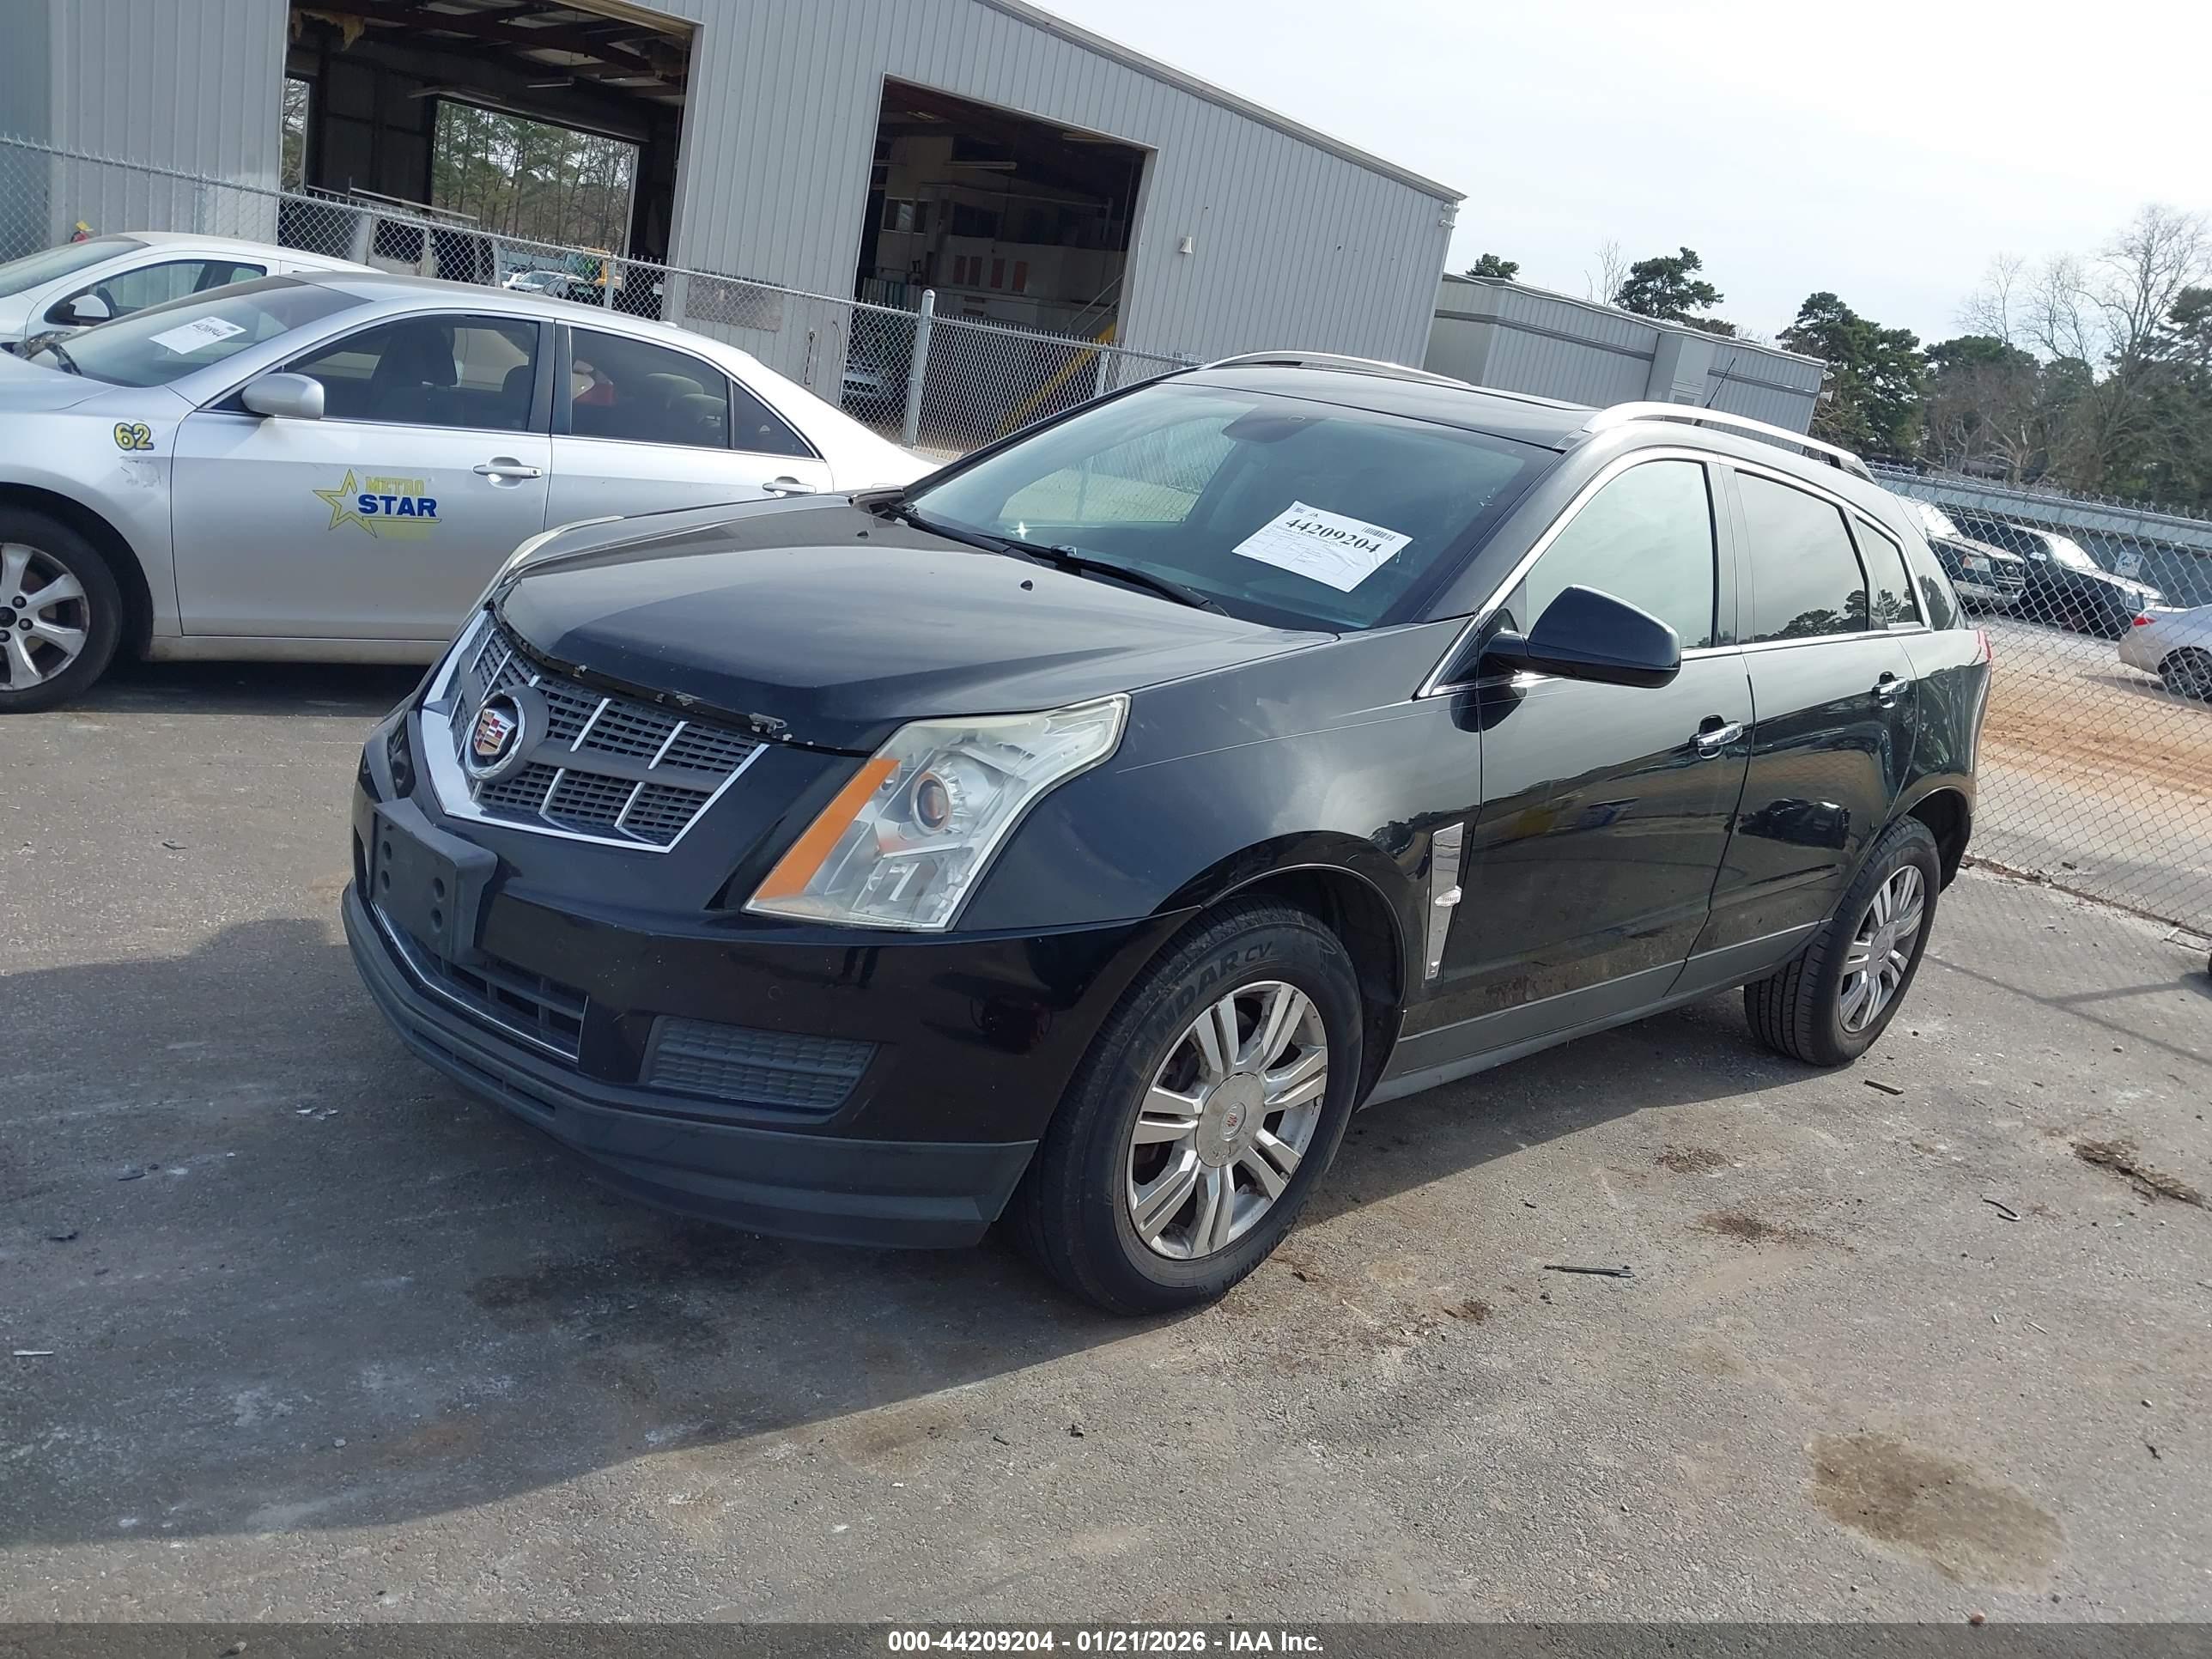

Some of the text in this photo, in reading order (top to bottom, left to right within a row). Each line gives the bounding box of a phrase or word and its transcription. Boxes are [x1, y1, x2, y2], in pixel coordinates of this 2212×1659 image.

[113, 422, 155, 451] 62
[365, 477, 424, 495] METRO
[358, 495, 437, 517] STAR
[1285, 519, 1382, 553] 44209204
